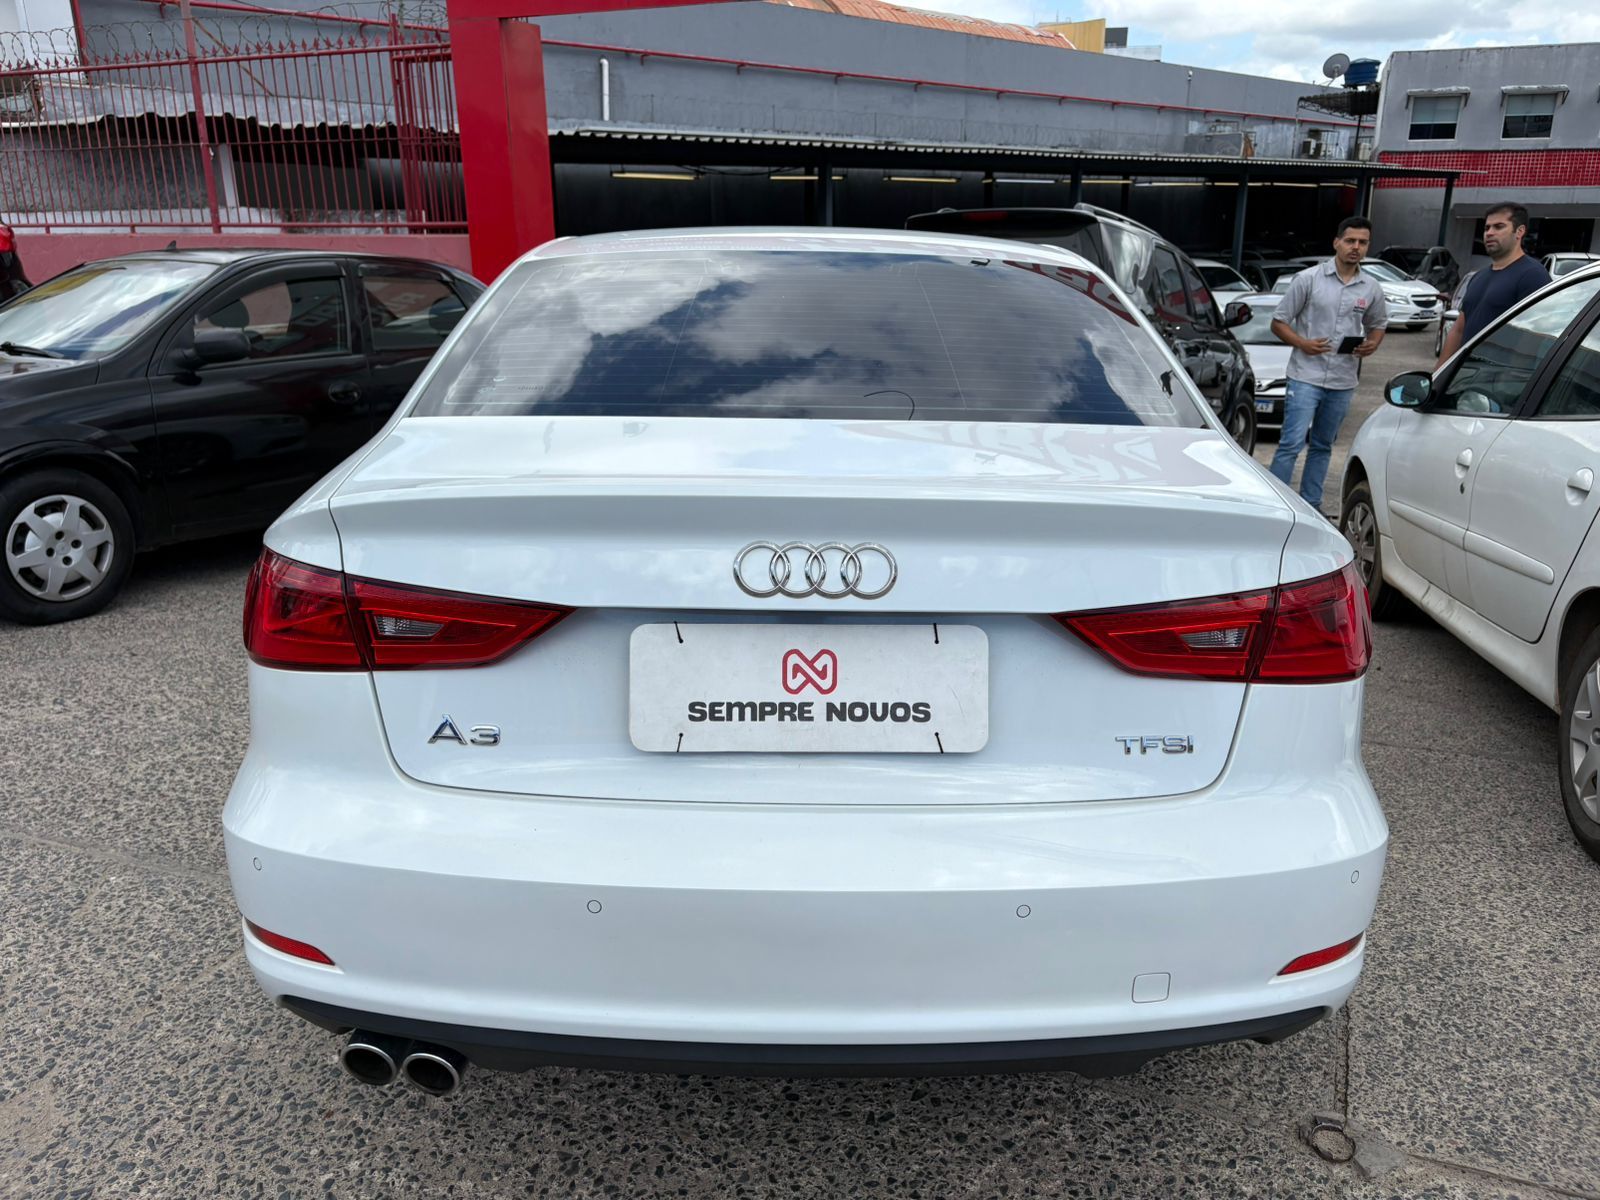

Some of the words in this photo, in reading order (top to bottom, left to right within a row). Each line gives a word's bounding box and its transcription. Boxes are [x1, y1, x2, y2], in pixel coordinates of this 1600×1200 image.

[688, 701, 815, 722] SEMPRE
[826, 702, 931, 722] NOVOS
[427, 714, 501, 746] A3
[1115, 735, 1194, 754] TFSI
